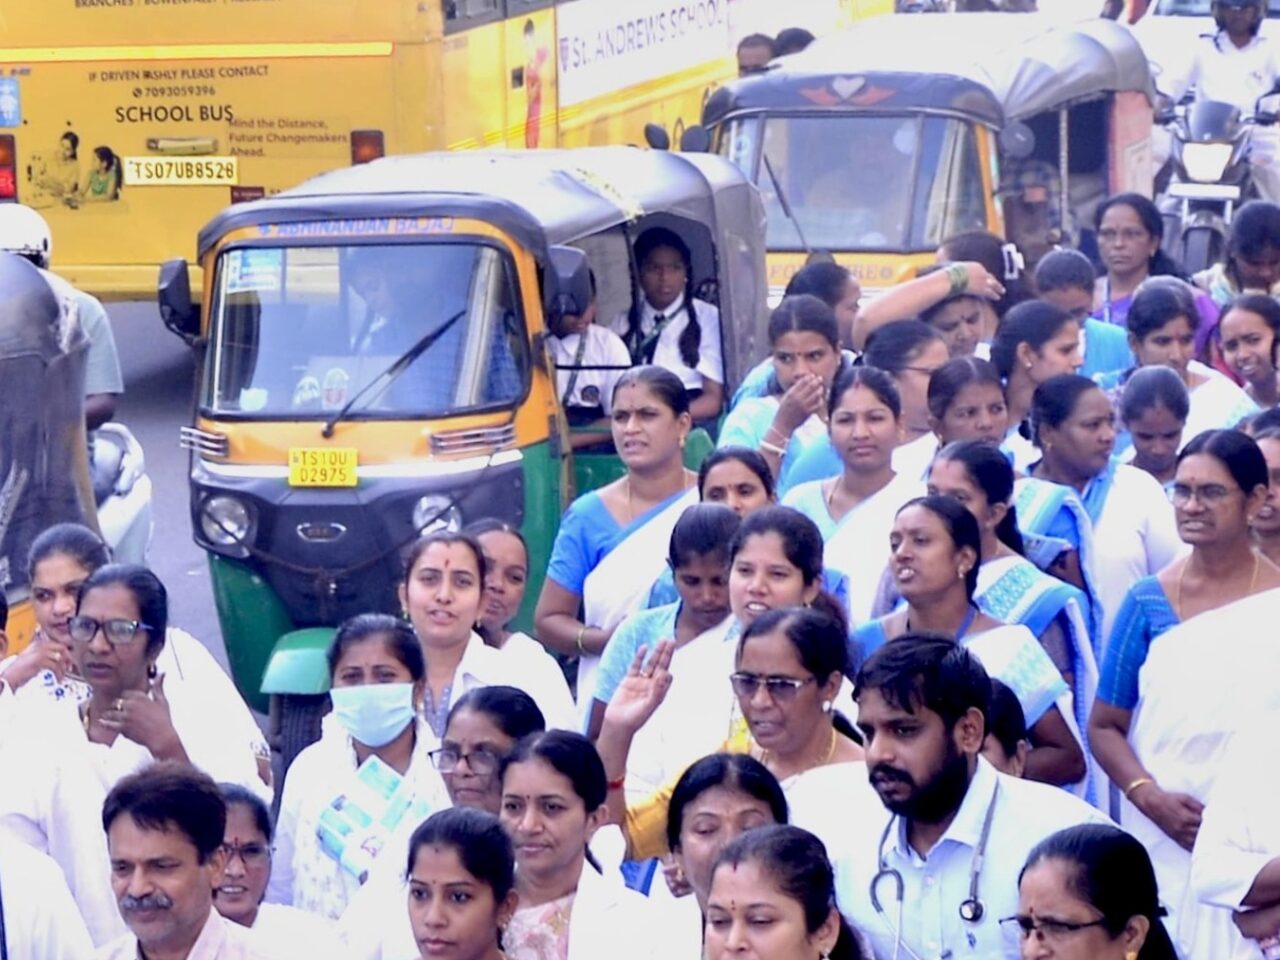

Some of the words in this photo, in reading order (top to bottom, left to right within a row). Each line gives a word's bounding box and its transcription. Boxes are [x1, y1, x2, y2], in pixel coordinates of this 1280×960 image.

[101, 70, 140, 81] DRIVEN
[181, 67, 215, 79] PLEASE
[219, 65, 269, 77] CONTACT
[116, 106, 193, 123] SCHOOL
[199, 105, 234, 122] BUS
[257, 119, 275, 128] the
[229, 133, 263, 143] Future
[266, 133, 348, 145] Changemakers
